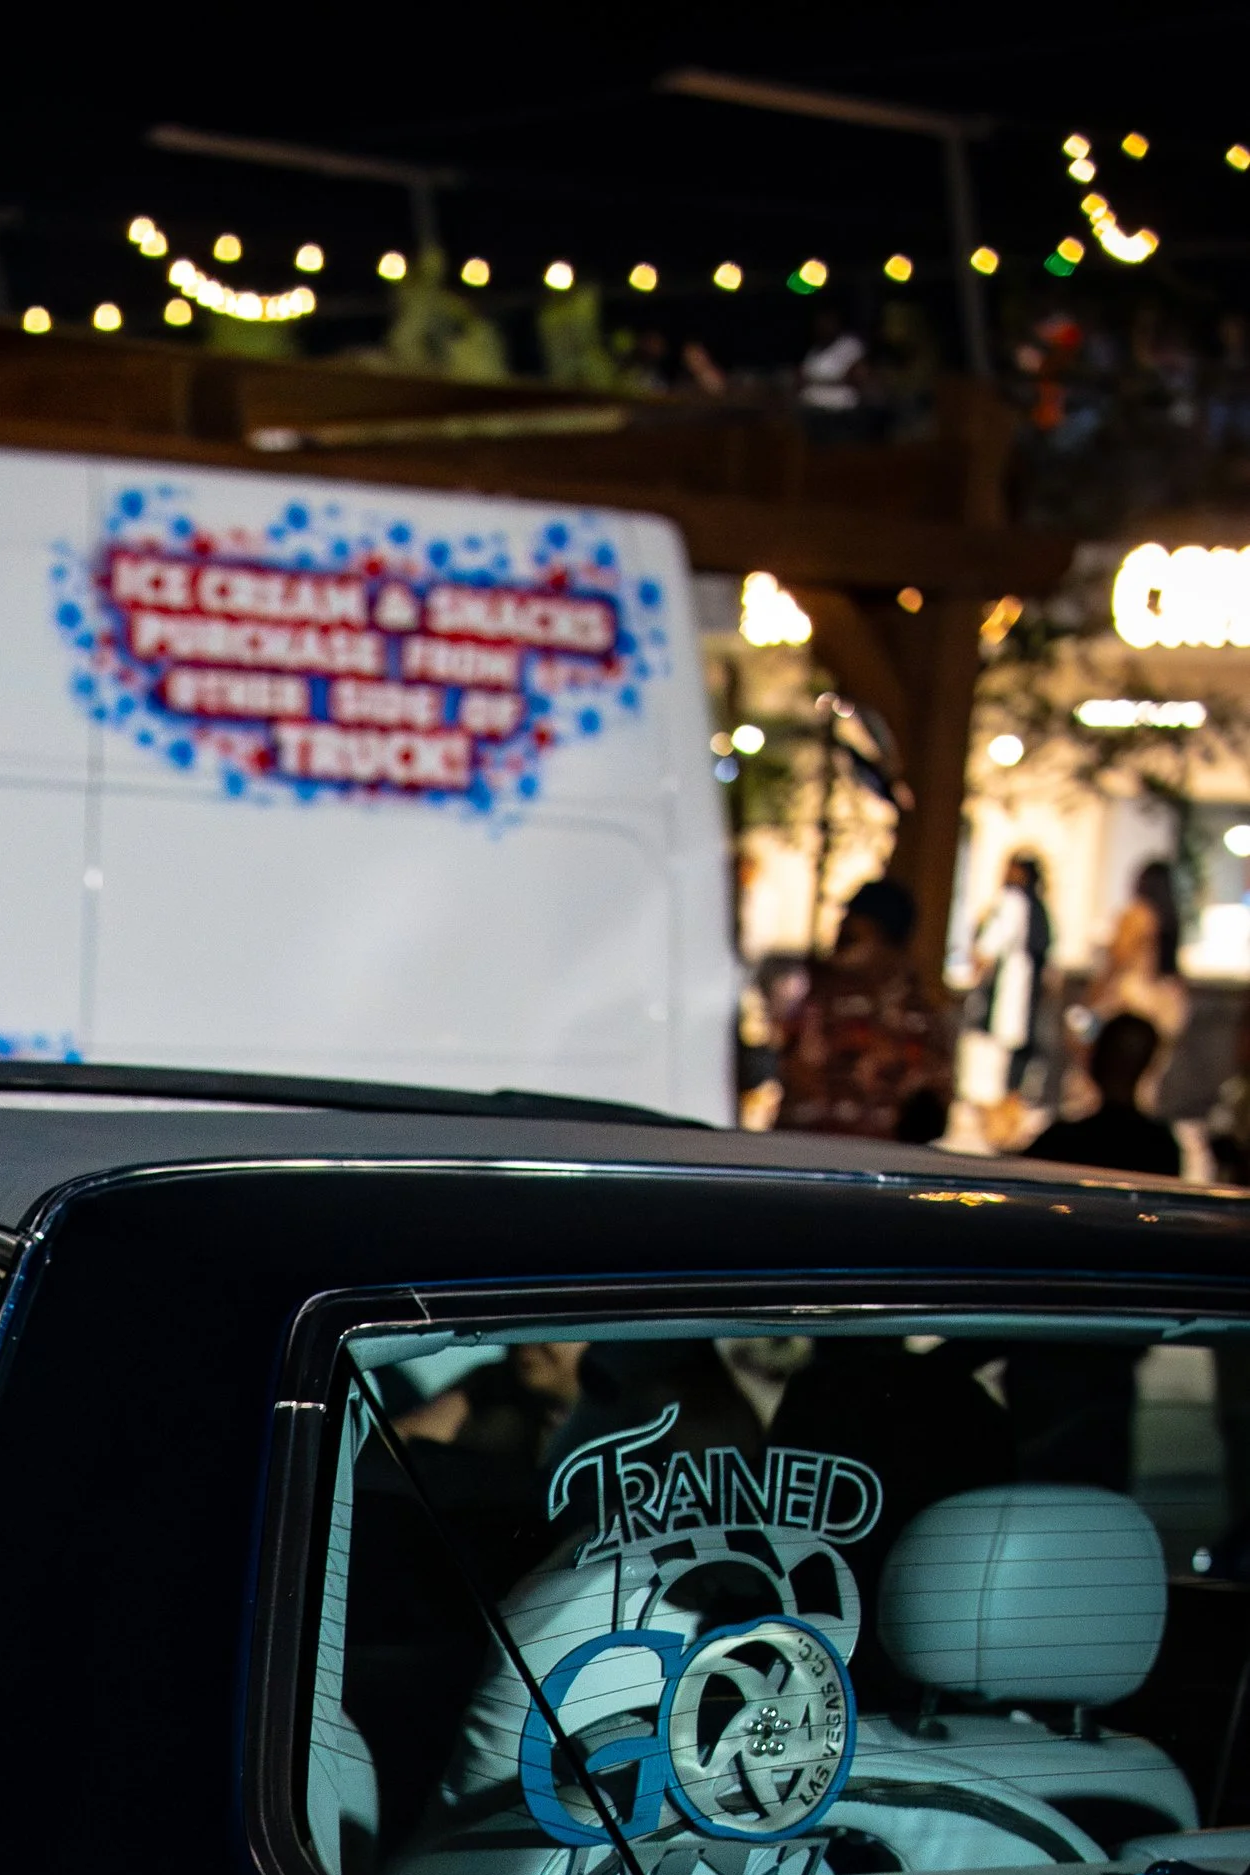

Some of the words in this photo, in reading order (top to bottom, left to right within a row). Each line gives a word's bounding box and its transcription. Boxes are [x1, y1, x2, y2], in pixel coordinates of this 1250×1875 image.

[112, 556, 189, 608] ICE
[196, 564, 368, 629] CREAM
[373, 581, 418, 631] &
[427, 586, 615, 652] SNACKS
[133, 613, 385, 675] PURCHASE
[401, 637, 519, 687] FROM
[164, 667, 310, 717] OTHER
[331, 679, 442, 729] SIDE
[461, 692, 523, 738] OF
[548, 1401, 883, 1571] TRAINED
[797, 1764, 831, 1808] LAS
[820, 1680, 843, 1759] VEGAS
